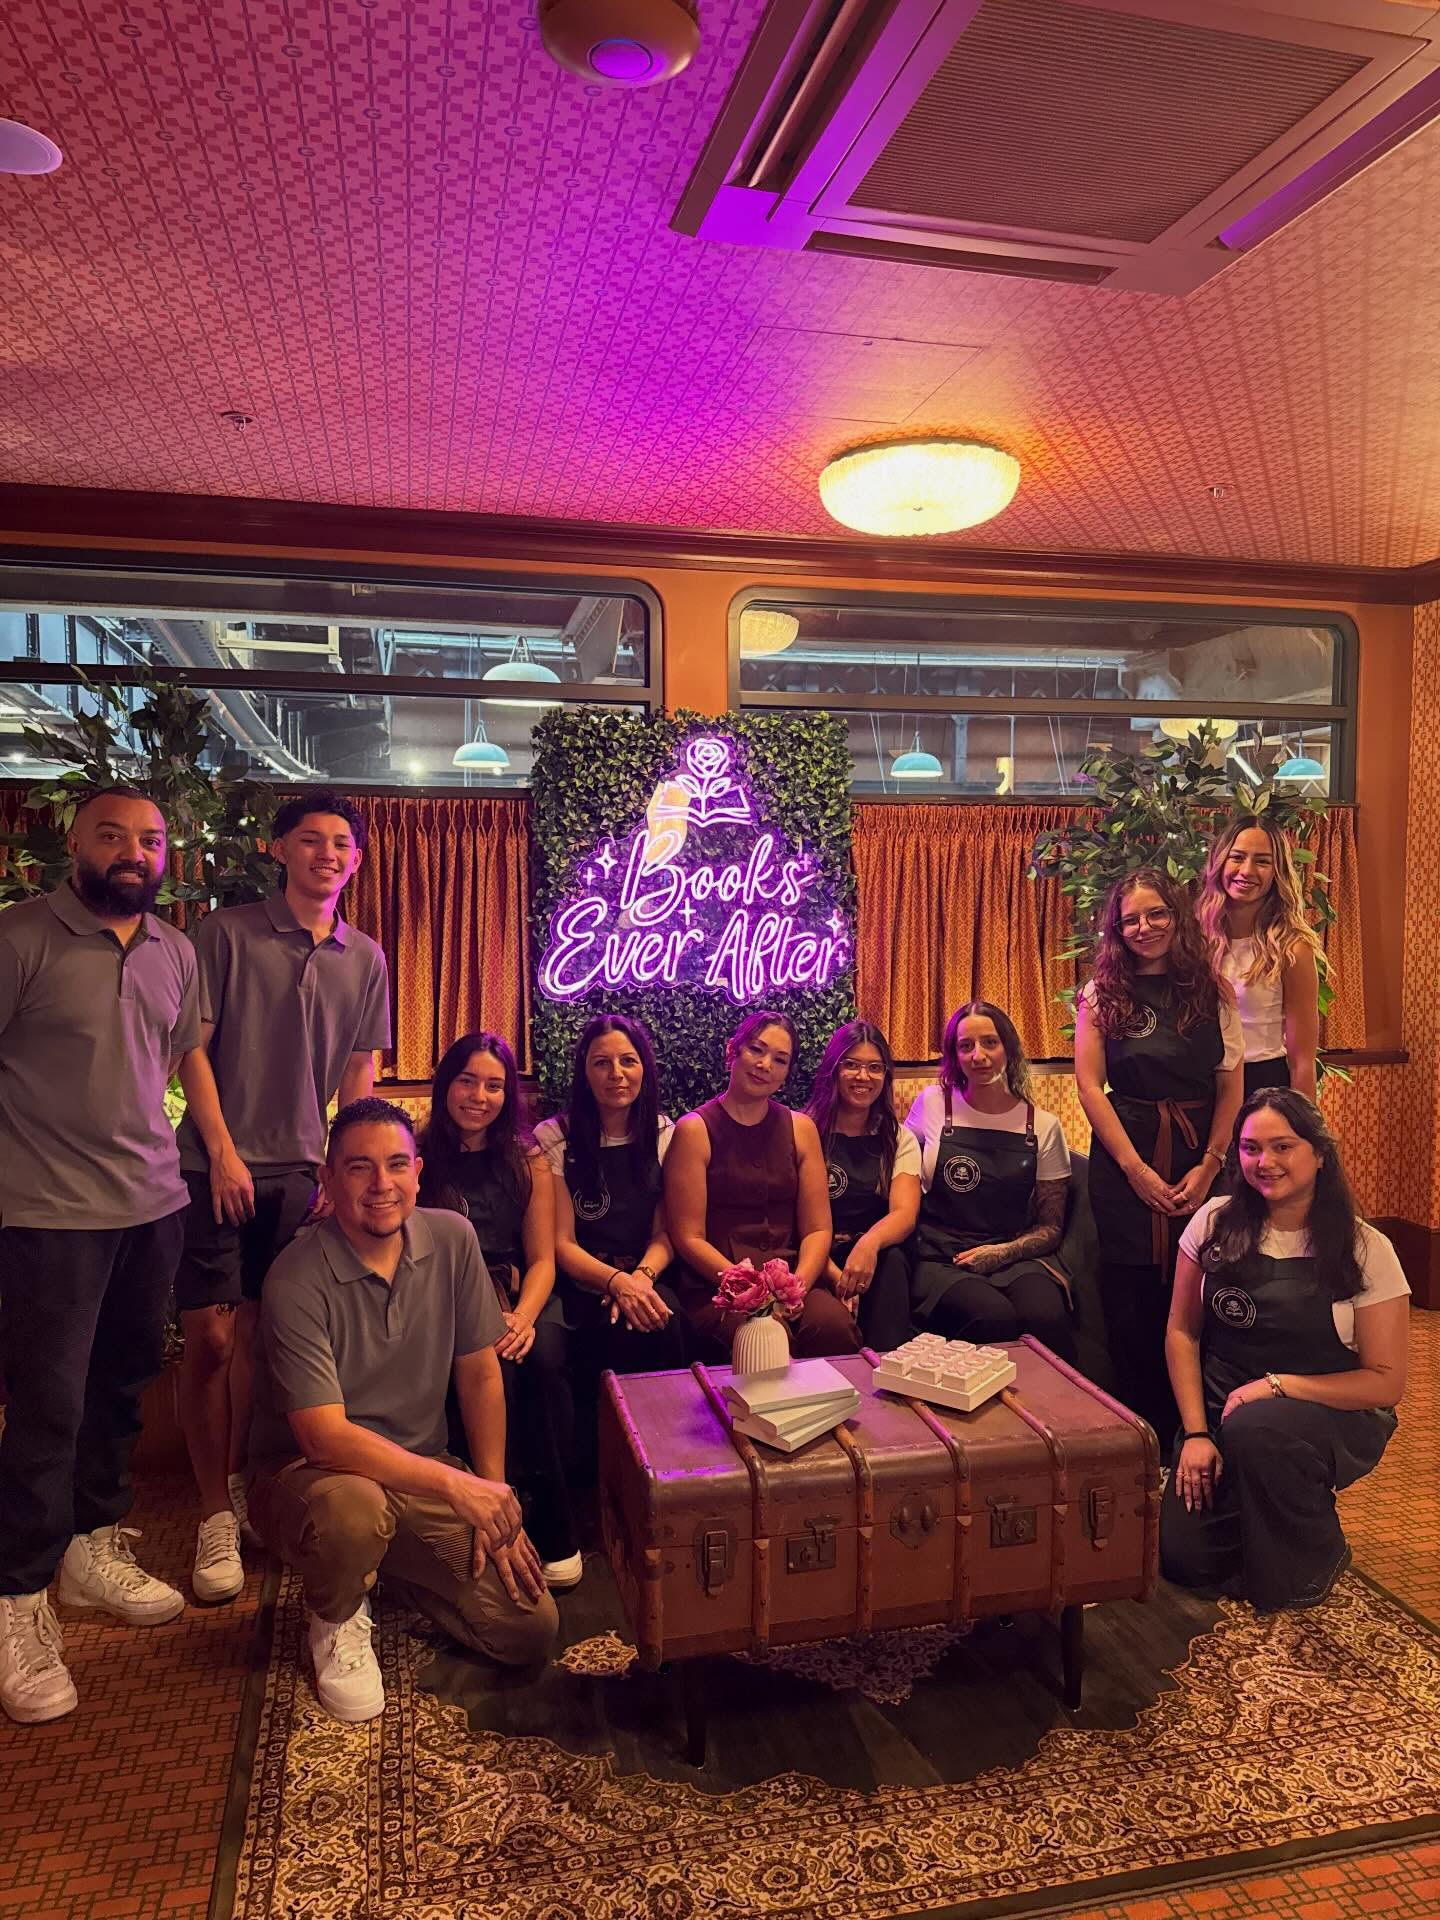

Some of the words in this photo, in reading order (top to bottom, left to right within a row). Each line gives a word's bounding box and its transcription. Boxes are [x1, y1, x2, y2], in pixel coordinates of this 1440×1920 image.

[118, 24, 142, 38] G
[281, 44, 303, 58] G
[59, 72, 82, 85] G
[214, 90, 234, 102] G
[363, 108, 382, 120] G
[155, 130, 175, 142] G
[620, 829, 817, 926] Books
[544, 896, 705, 995] Ever
[705, 909, 849, 999] After
